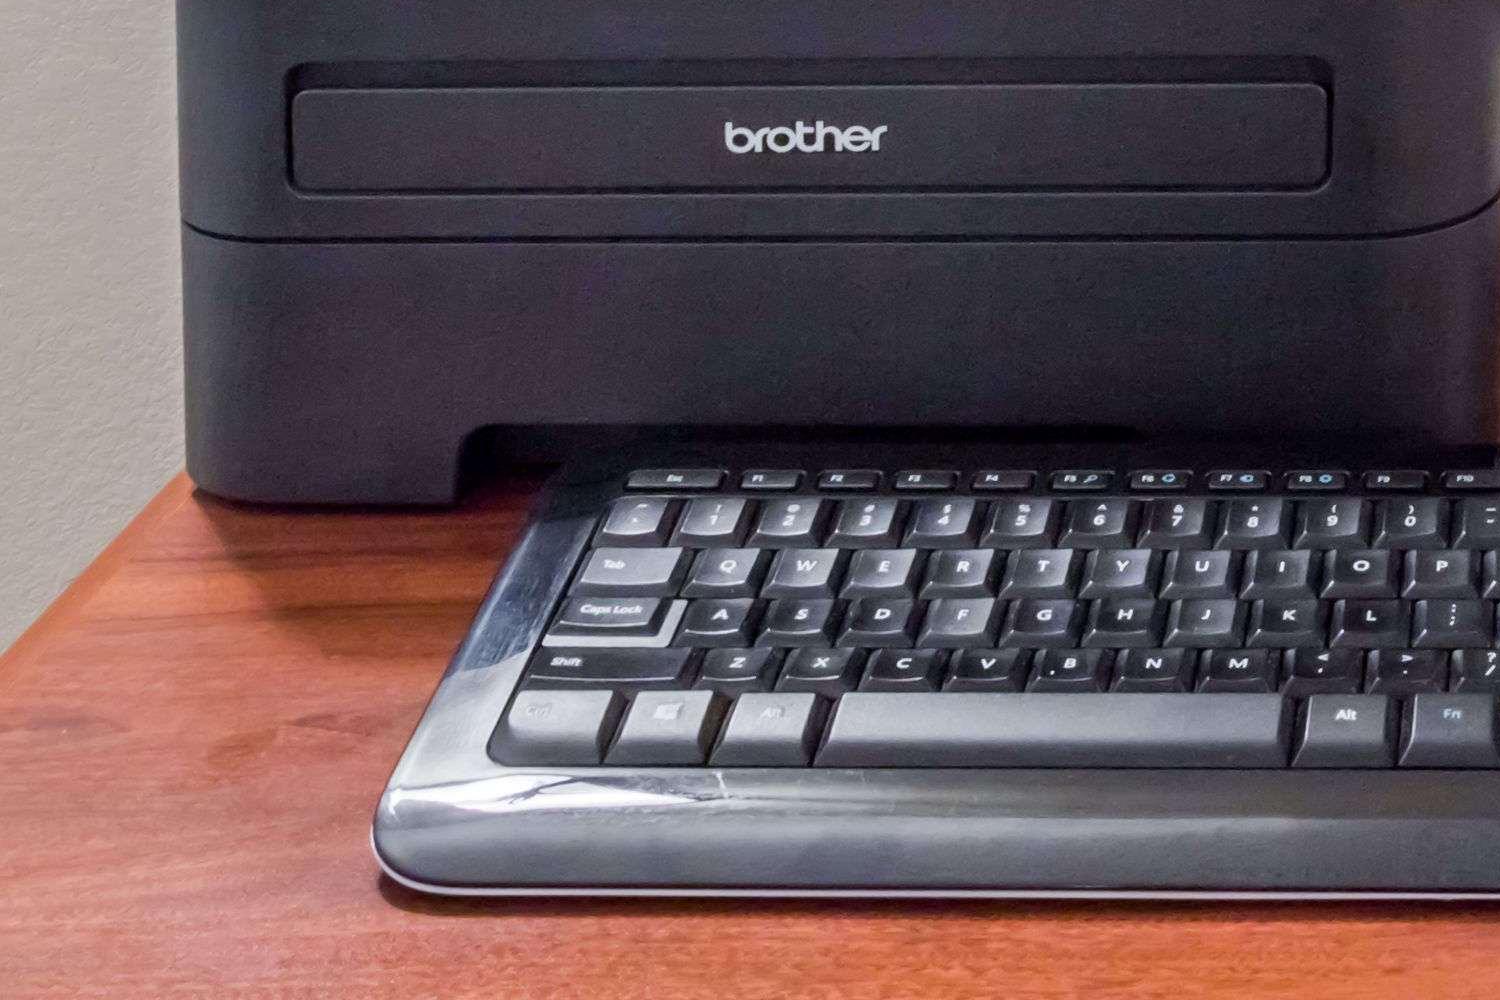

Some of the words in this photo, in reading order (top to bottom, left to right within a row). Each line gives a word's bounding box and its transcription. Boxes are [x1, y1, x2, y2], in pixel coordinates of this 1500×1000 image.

[725, 121, 888, 154] brother
[710, 515, 718, 525] 1
[782, 516, 795, 526] 2
[860, 515, 872, 526] 3
[938, 515, 949, 525] 4
[1015, 515, 1026, 526] 5
[1094, 515, 1105, 525] 6
[1172, 515, 1182, 526] 7
[1247, 517, 1258, 527] 8
[1327, 515, 1338, 526] 9
[1404, 516, 1416, 527] 0
[604, 560, 625, 569] Tab
[720, 560, 736, 573] Q
[797, 560, 817, 571] W
[879, 561, 890, 572] E
[957, 561, 970, 572] R
[1039, 560, 1050, 571] T
[1117, 560, 1129, 572] Y
[1195, 561, 1209, 572] U
[1353, 560, 1370, 571] O
[1436, 560, 1448, 571] P
[580, 604, 609, 615] Caps
[612, 604, 643, 614] Lock
[712, 609, 729, 620] A
[795, 609, 808, 620] S
[875, 609, 891, 619] D
[958, 609, 969, 620] F
[1037, 609, 1052, 620] G
[1118, 609, 1133, 620] H
[1201, 609, 1211, 620] J
[1283, 610, 1296, 620] K
[1366, 610, 1376, 621] L
[551, 657, 582, 666] Shift
[729, 657, 746, 668] Z
[813, 657, 830, 668] X
[897, 658, 912, 668] C
[981, 658, 996, 669] V
[1064, 658, 1076, 668] B
[1146, 658, 1162, 668] N
[1229, 658, 1248, 668] M
[1335, 709, 1356, 720] Alt
[1444, 709, 1461, 719] Fn
